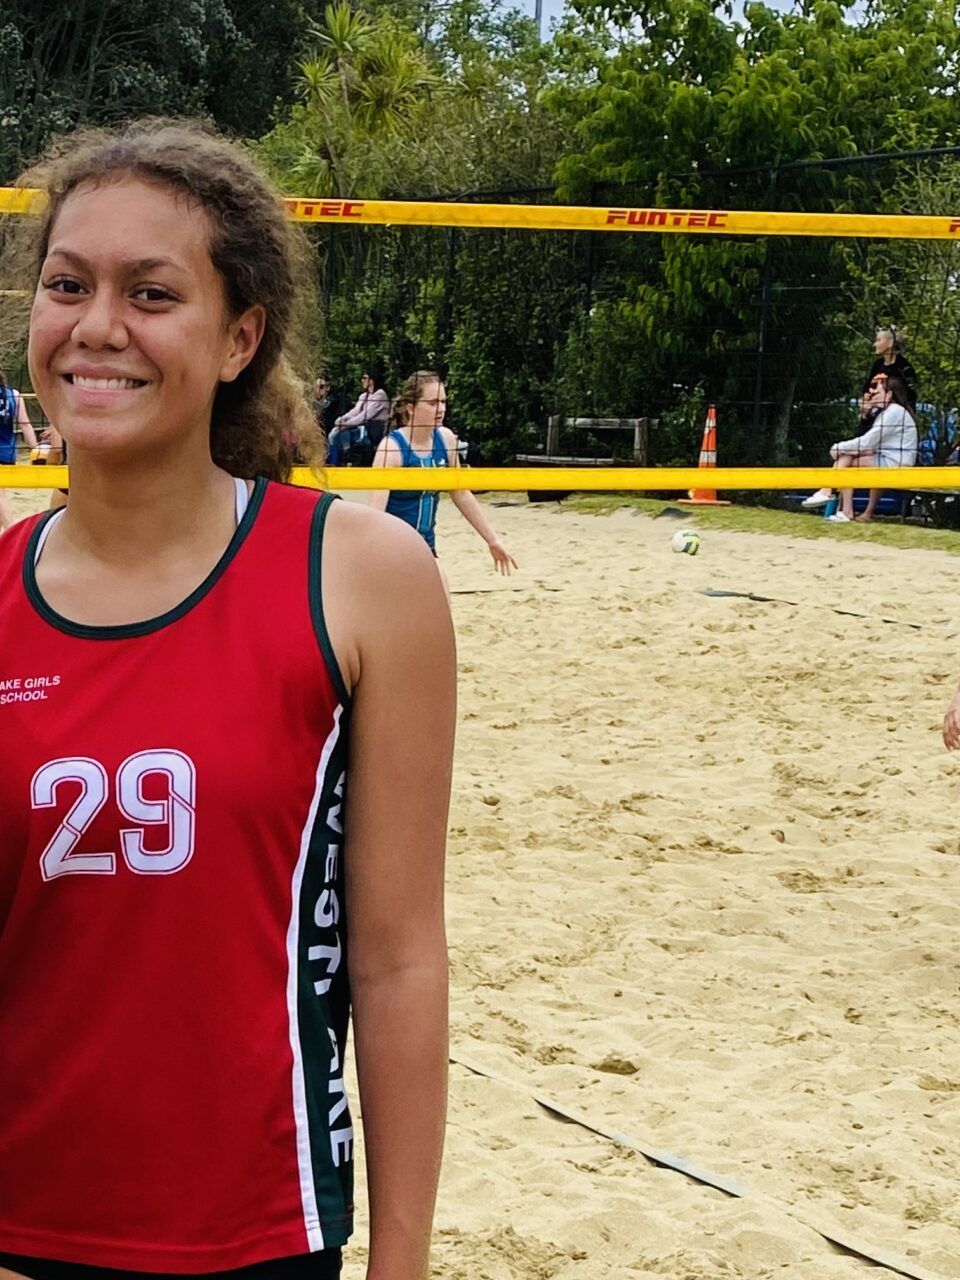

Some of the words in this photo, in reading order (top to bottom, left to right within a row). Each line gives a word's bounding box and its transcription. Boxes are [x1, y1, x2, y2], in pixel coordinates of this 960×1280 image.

[606, 210, 728, 227] FUNTEC
[24, 675, 61, 689] GIRLS
[0, 689, 48, 705] SCHOOL
[30, 748, 197, 882] 29
